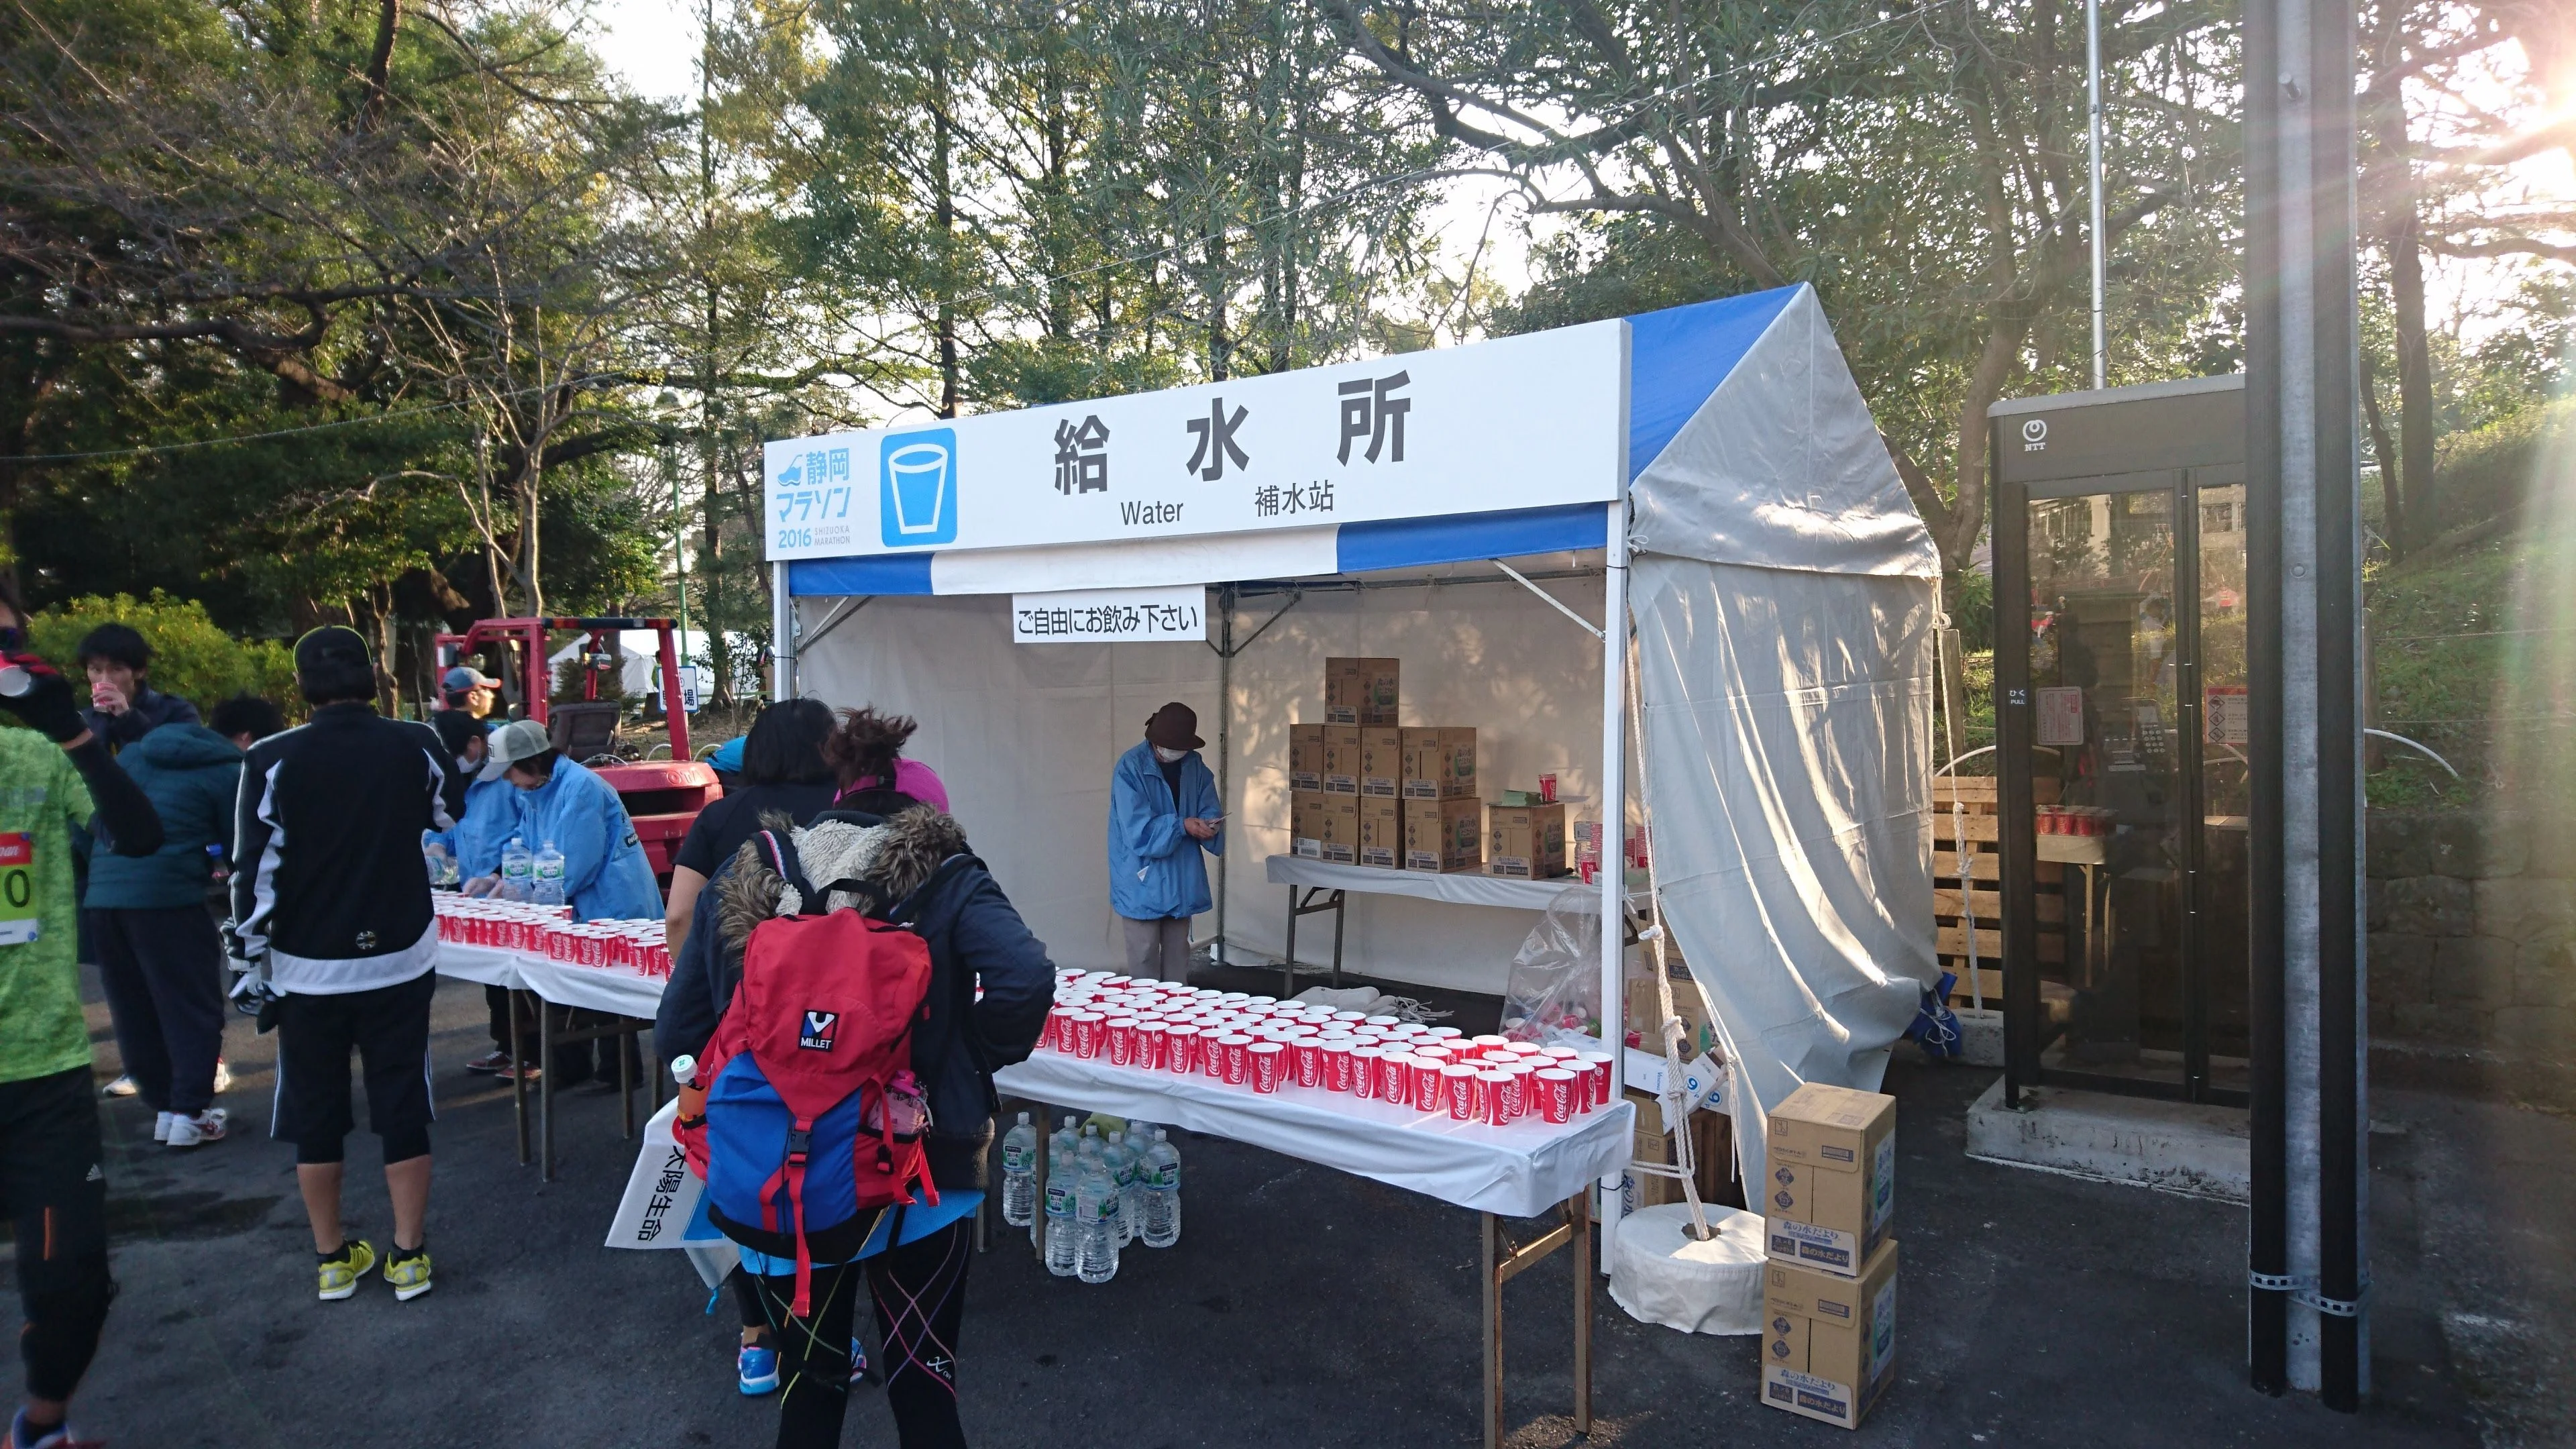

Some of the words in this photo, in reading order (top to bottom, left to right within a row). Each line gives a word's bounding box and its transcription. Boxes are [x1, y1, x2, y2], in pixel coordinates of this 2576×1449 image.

[1054, 370, 1411, 496] 給水所
[2024, 442, 2046, 451] NTT
[806, 447, 849, 484] 静岡
[776, 486, 851, 523] マラソン
[1121, 500, 1183, 526] Water
[1254, 480, 1334, 518] 補水站
[778, 528, 812, 548] 2016
[814, 525, 850, 536] SHIZUOKA
[814, 536, 851, 546] MARATHON
[1018, 604, 1197, 635] ご自由にお飲み下さい
[800, 1036, 832, 1050] MILLET
[1077, 1023, 1089, 1057] Coca-Cola
[1112, 1029, 1124, 1064] Coca-Cola
[1171, 1036, 1183, 1072] Coca-Cola
[1208, 1039, 1220, 1075] Coca-Cola
[1229, 1046, 1241, 1083] Coca-Cola
[1258, 1055, 1271, 1091] Coca-Cola
[1301, 1049, 1313, 1085] Coca-Cola
[1337, 1054, 1349, 1090] Coca-Cola
[1354, 1059, 1366, 1097] Coca-Cola
[1385, 1063, 1398, 1102] Coca-Cola
[1421, 1071, 1435, 1110] Coca-Cola
[1453, 1079, 1468, 1118] Coca-Cola
[1554, 1082, 1567, 1122] Coca-Cola
[637, 1145, 686, 1242] 太陽生命
[1782, 1221, 1839, 1239] 森の水だより
